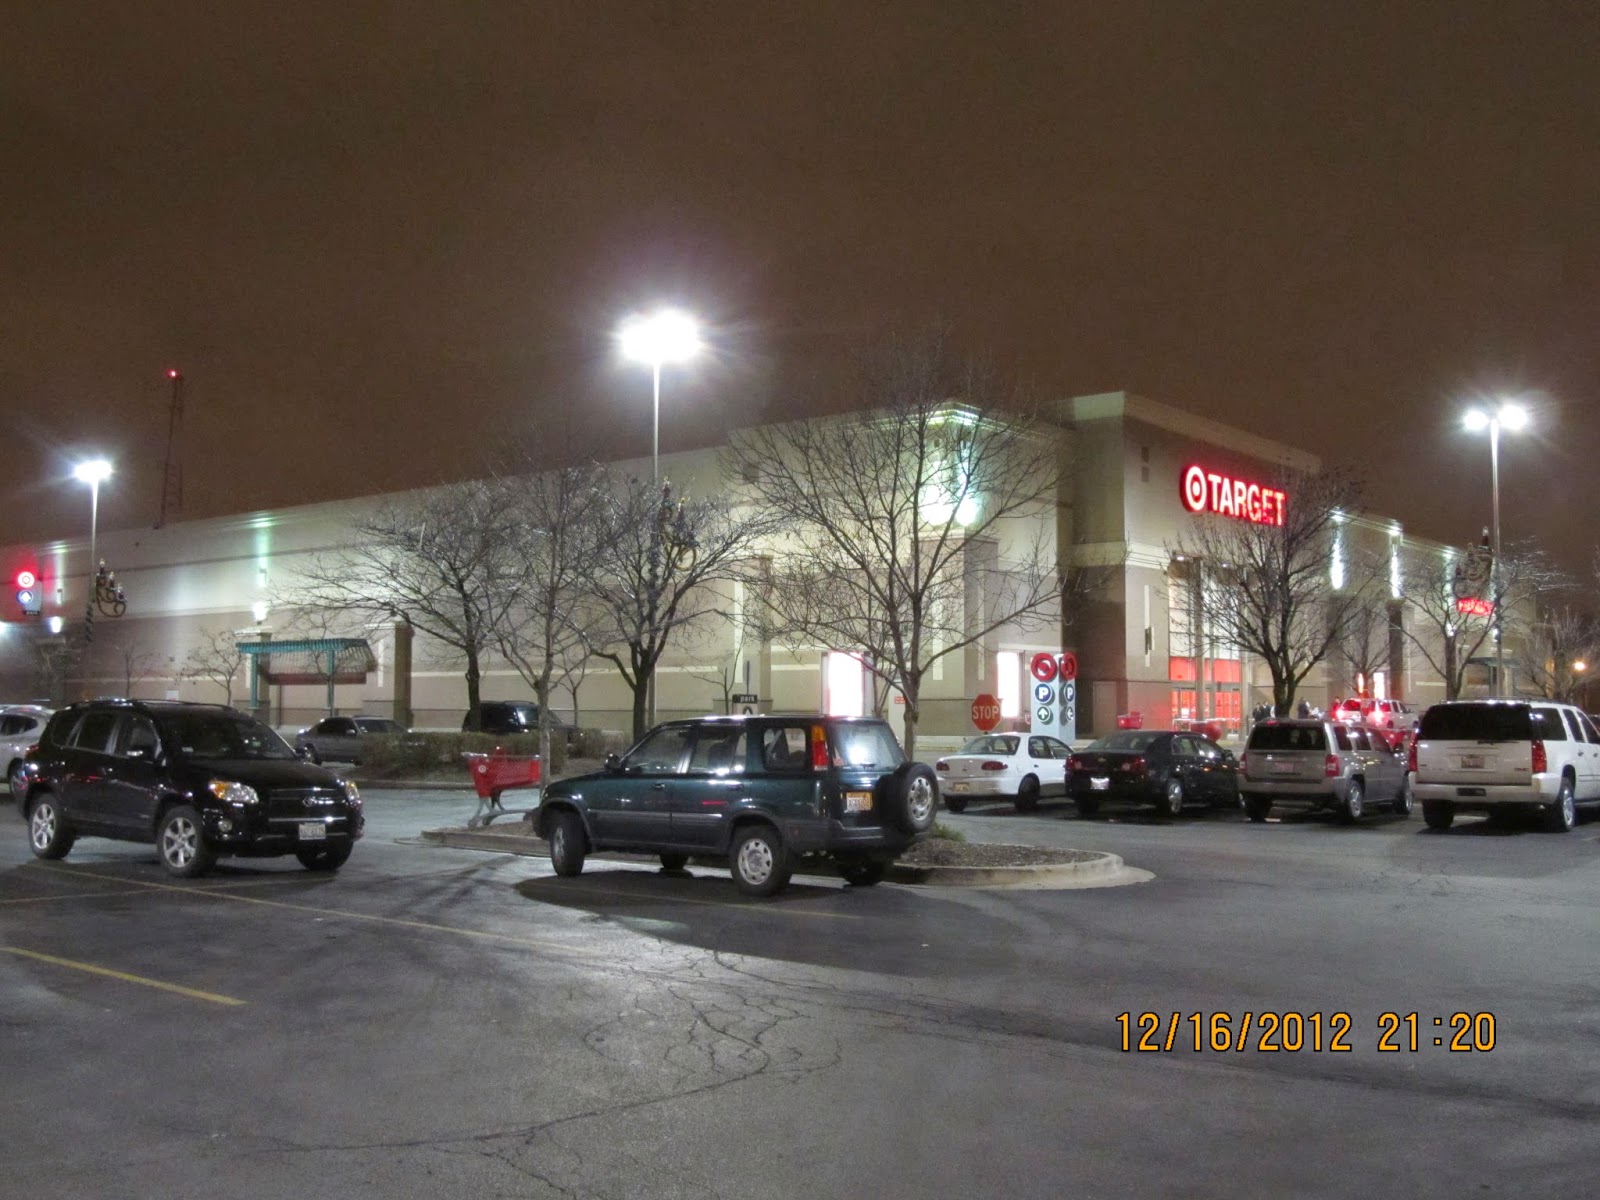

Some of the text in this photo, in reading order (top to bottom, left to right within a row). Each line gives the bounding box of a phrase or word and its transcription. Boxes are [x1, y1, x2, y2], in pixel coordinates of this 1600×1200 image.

[1208, 473, 1286, 526] TARGET
[740, 695, 755, 703] park
[1038, 686, 1049, 699] P
[972, 705, 999, 720] STOP
